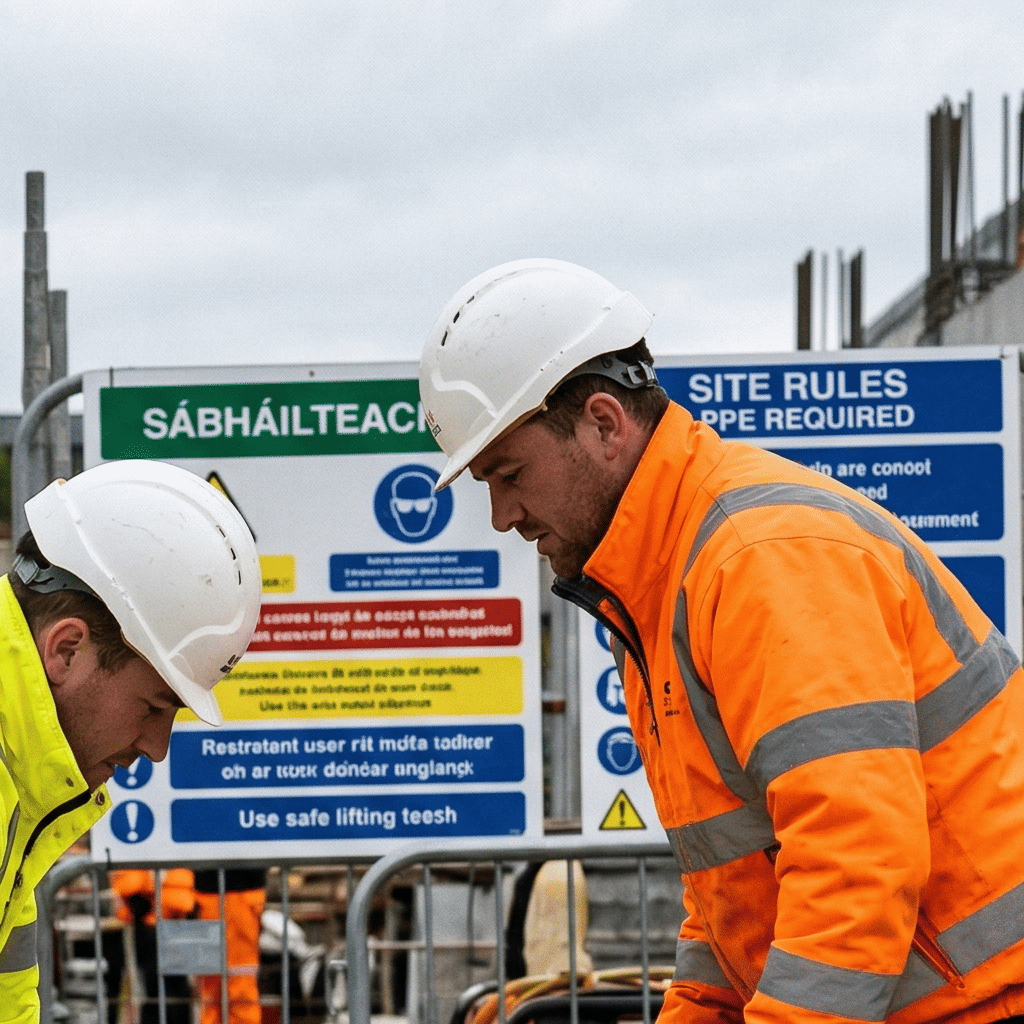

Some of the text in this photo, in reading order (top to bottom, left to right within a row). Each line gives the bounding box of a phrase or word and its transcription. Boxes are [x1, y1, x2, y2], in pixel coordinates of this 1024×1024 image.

[688, 368, 908, 404] SITE RULES
[701, 404, 915, 432] PPE REQUIRED
[837, 462, 867, 477] are
[239, 809, 280, 828] Use
[285, 808, 330, 828] safe
[336, 806, 396, 830] lifting
